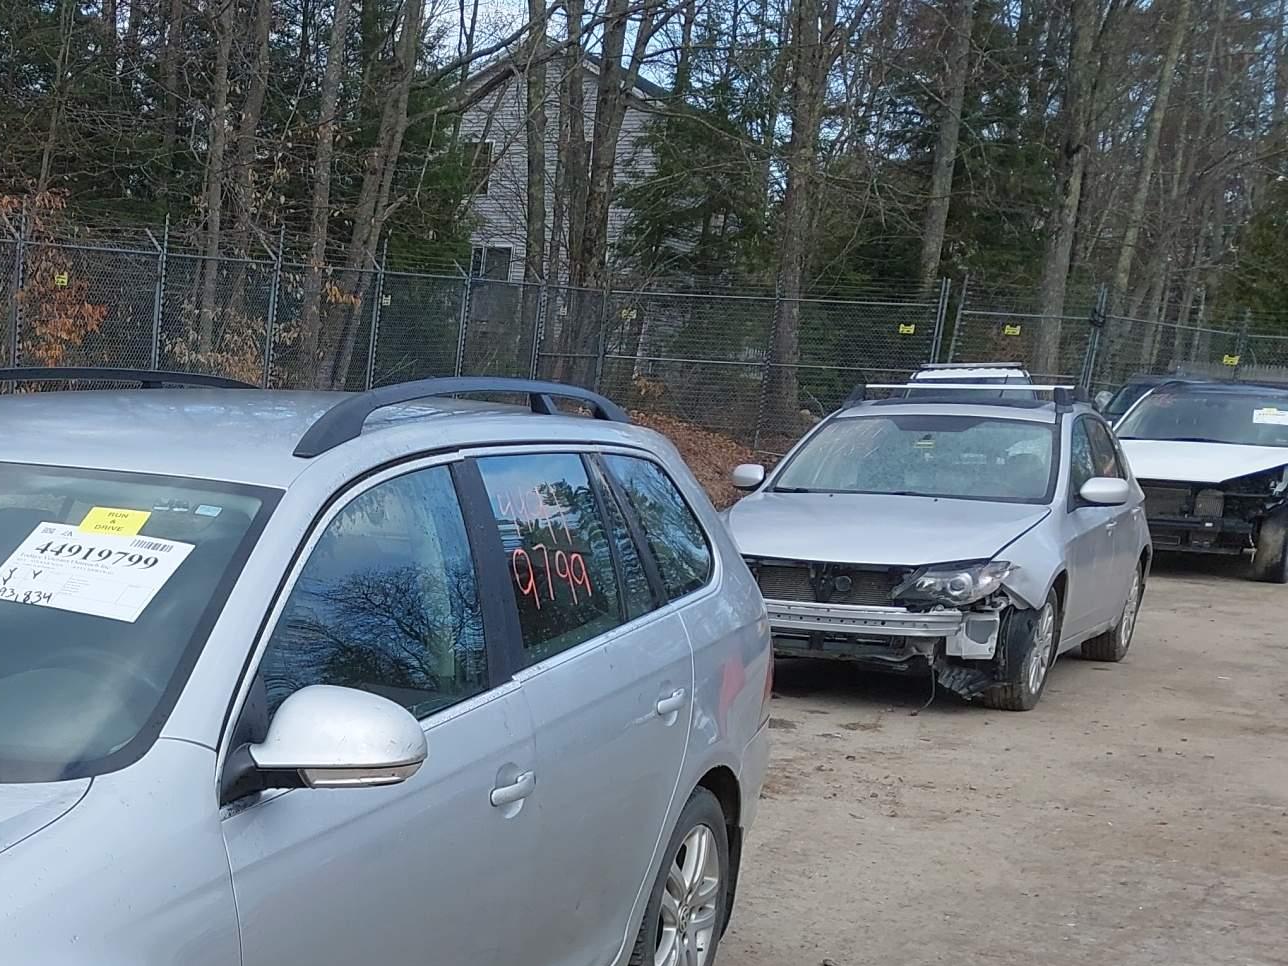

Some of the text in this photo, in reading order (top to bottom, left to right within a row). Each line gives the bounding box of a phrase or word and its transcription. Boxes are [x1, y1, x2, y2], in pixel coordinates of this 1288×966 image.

[94, 524, 124, 532] DRIVE
[35, 540, 159, 569] 44919799
[513, 543, 592, 610] 9799
